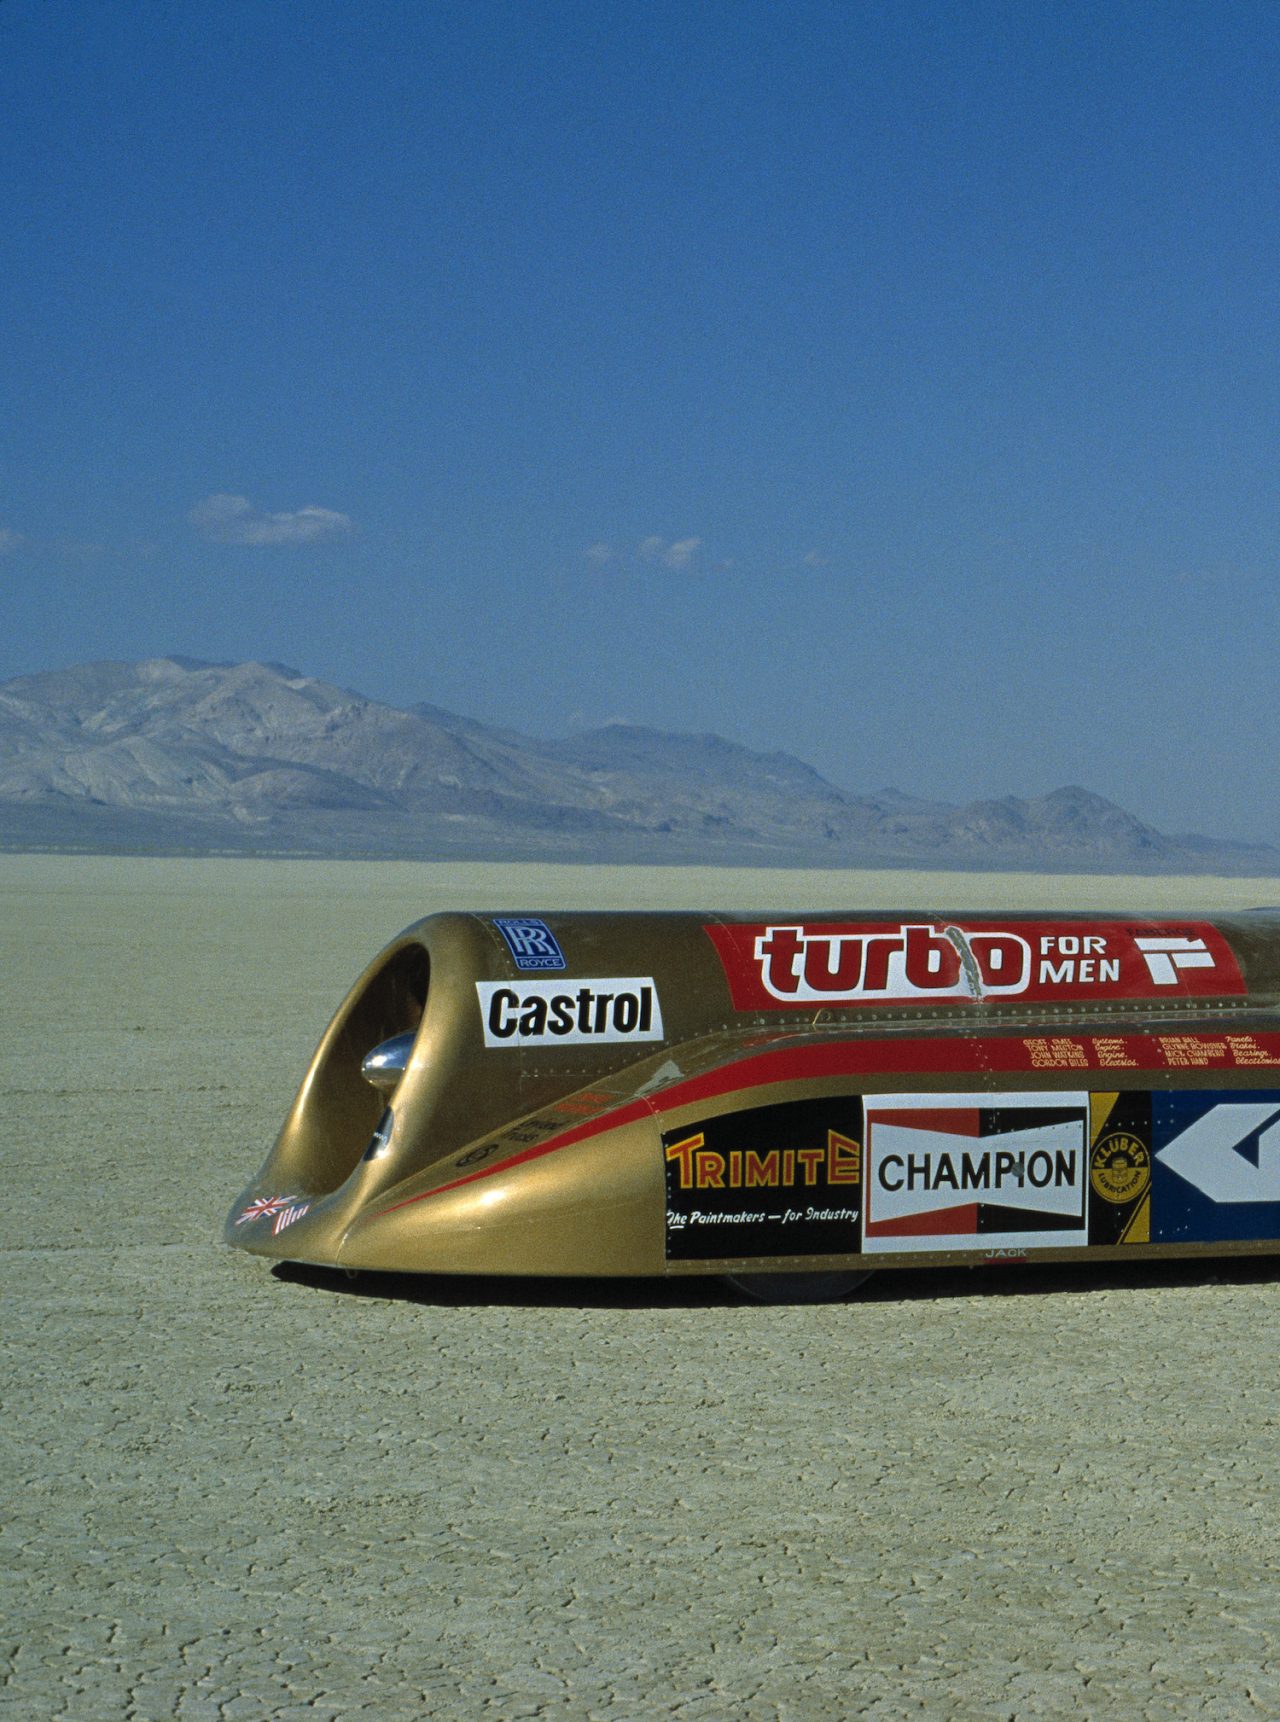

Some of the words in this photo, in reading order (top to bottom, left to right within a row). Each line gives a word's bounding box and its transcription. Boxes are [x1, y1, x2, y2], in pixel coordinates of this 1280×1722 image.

[1040, 936, 1107, 955] FOR
[519, 958, 562, 967] ROYCE
[760, 927, 1027, 995] turbo
[1039, 958, 1120, 984] MEN
[489, 986, 652, 1039] Castrol
[665, 1129, 861, 1189] TRIMITE
[878, 1150, 1076, 1192] CHAMPION
[1098, 1170, 1142, 1194] LUBRICATION
[666, 1211, 688, 1225] The
[690, 1210, 766, 1225] Paintmakers
[782, 1209, 803, 1224] for
[804, 1206, 859, 1223] Industry
[985, 1247, 1027, 1258] JACK
